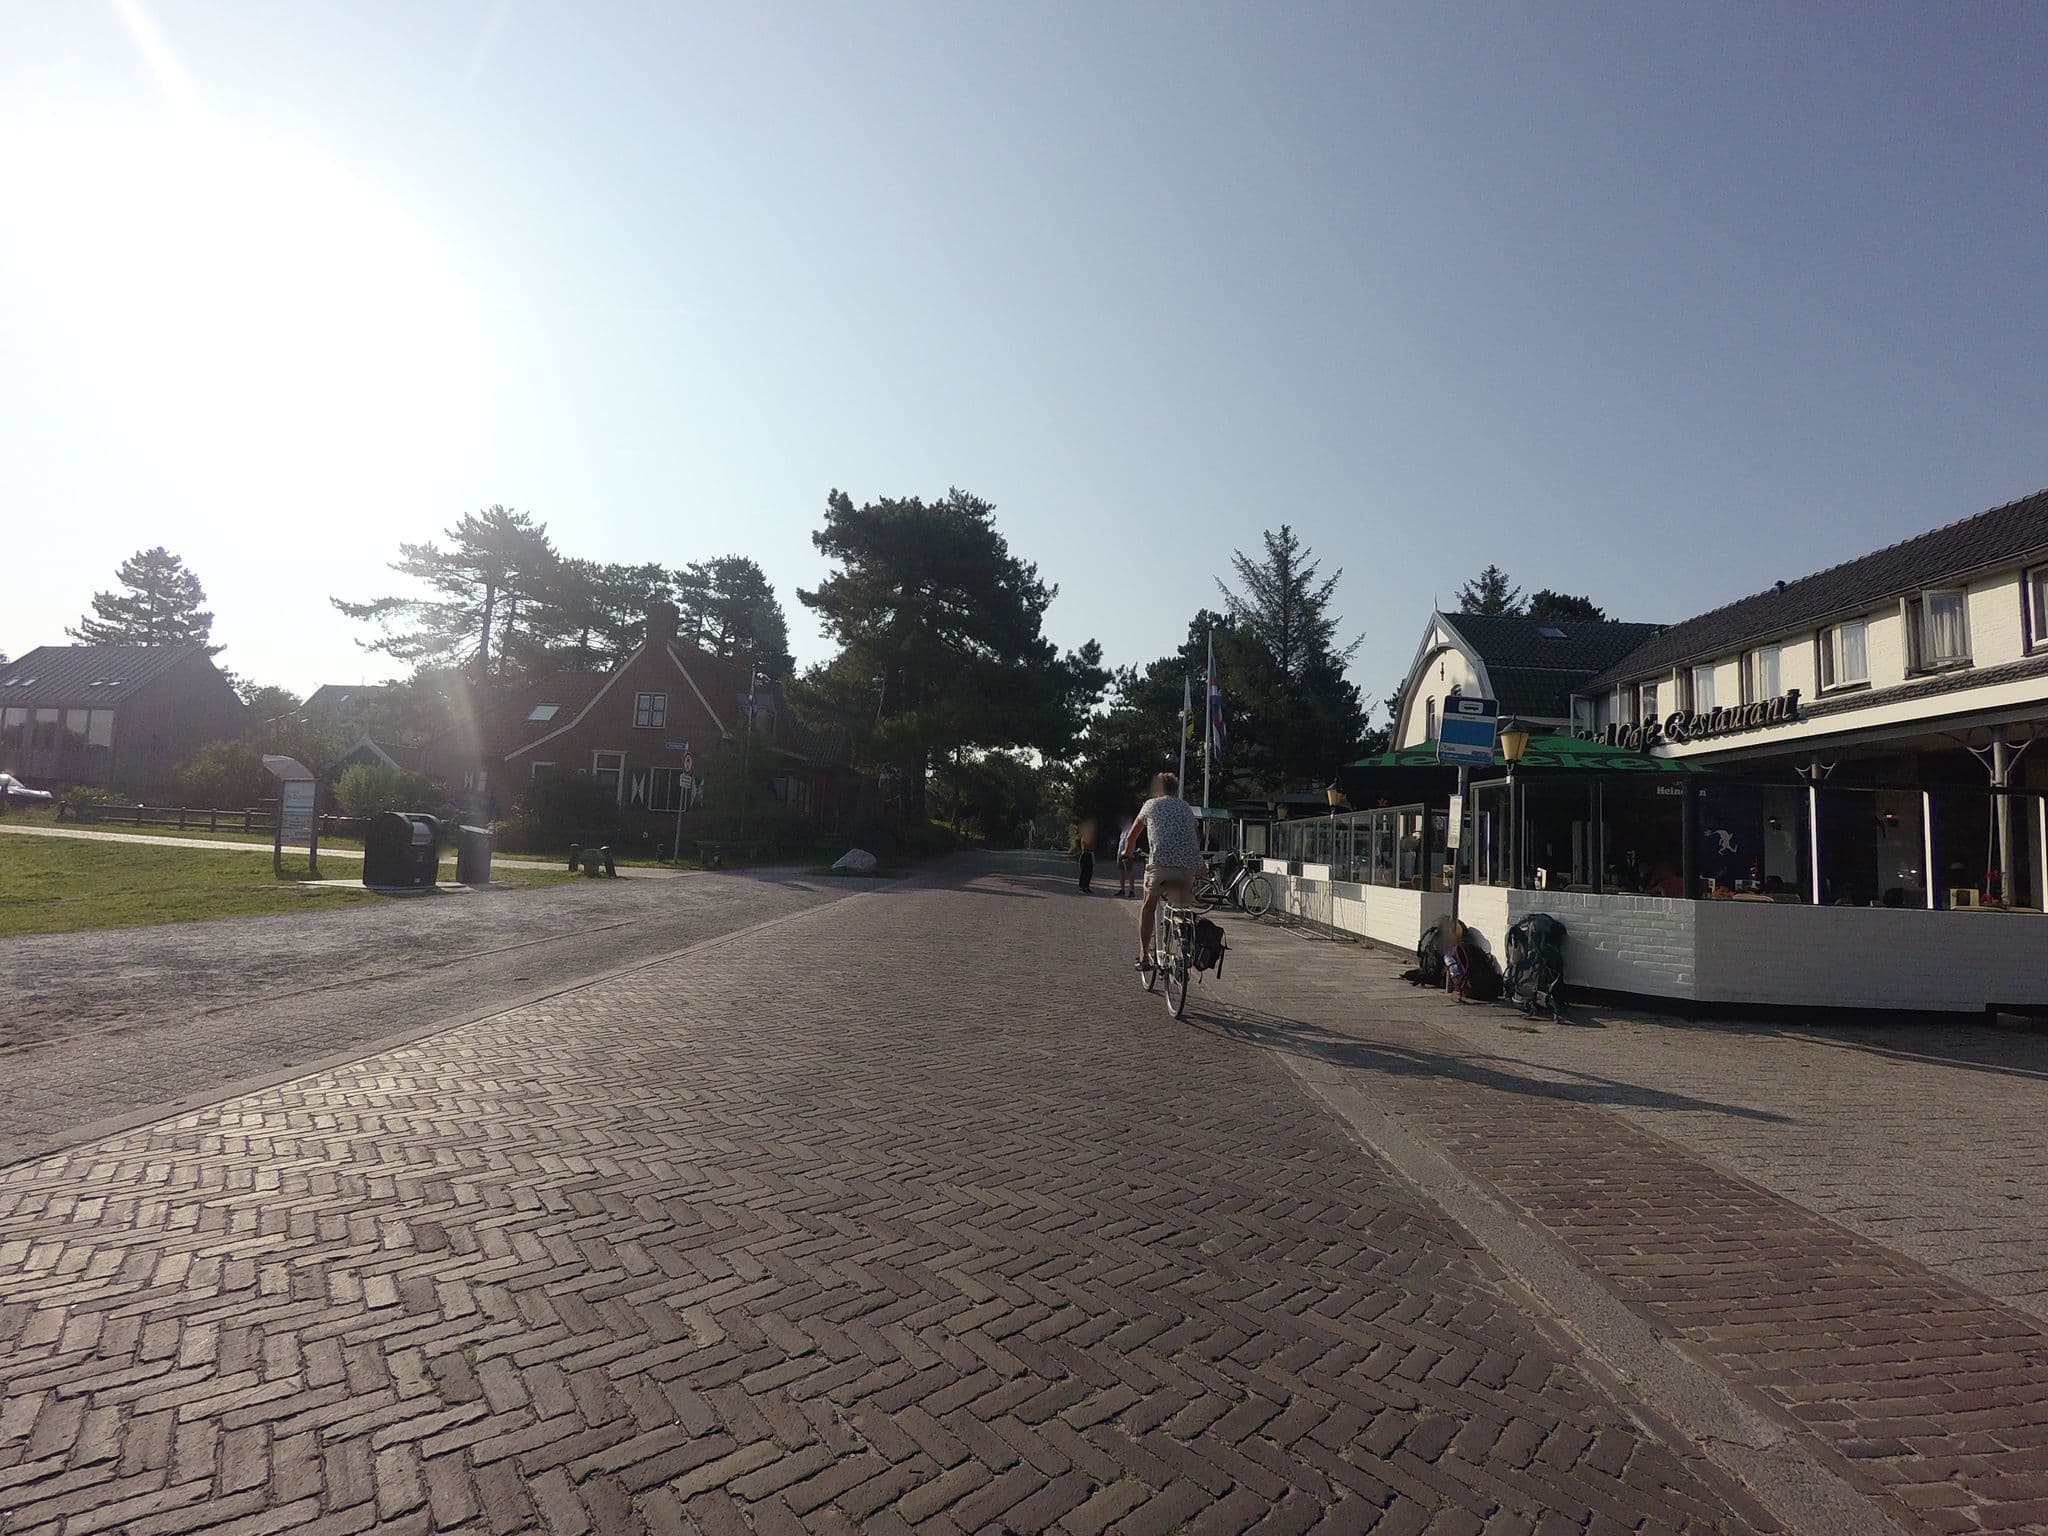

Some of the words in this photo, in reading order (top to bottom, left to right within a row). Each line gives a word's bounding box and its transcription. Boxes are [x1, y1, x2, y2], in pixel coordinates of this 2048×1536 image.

[1663, 691, 1798, 741] Restaurant
[1354, 752, 1713, 772] Heeken
[1656, 786, 1707, 797] Heinn
